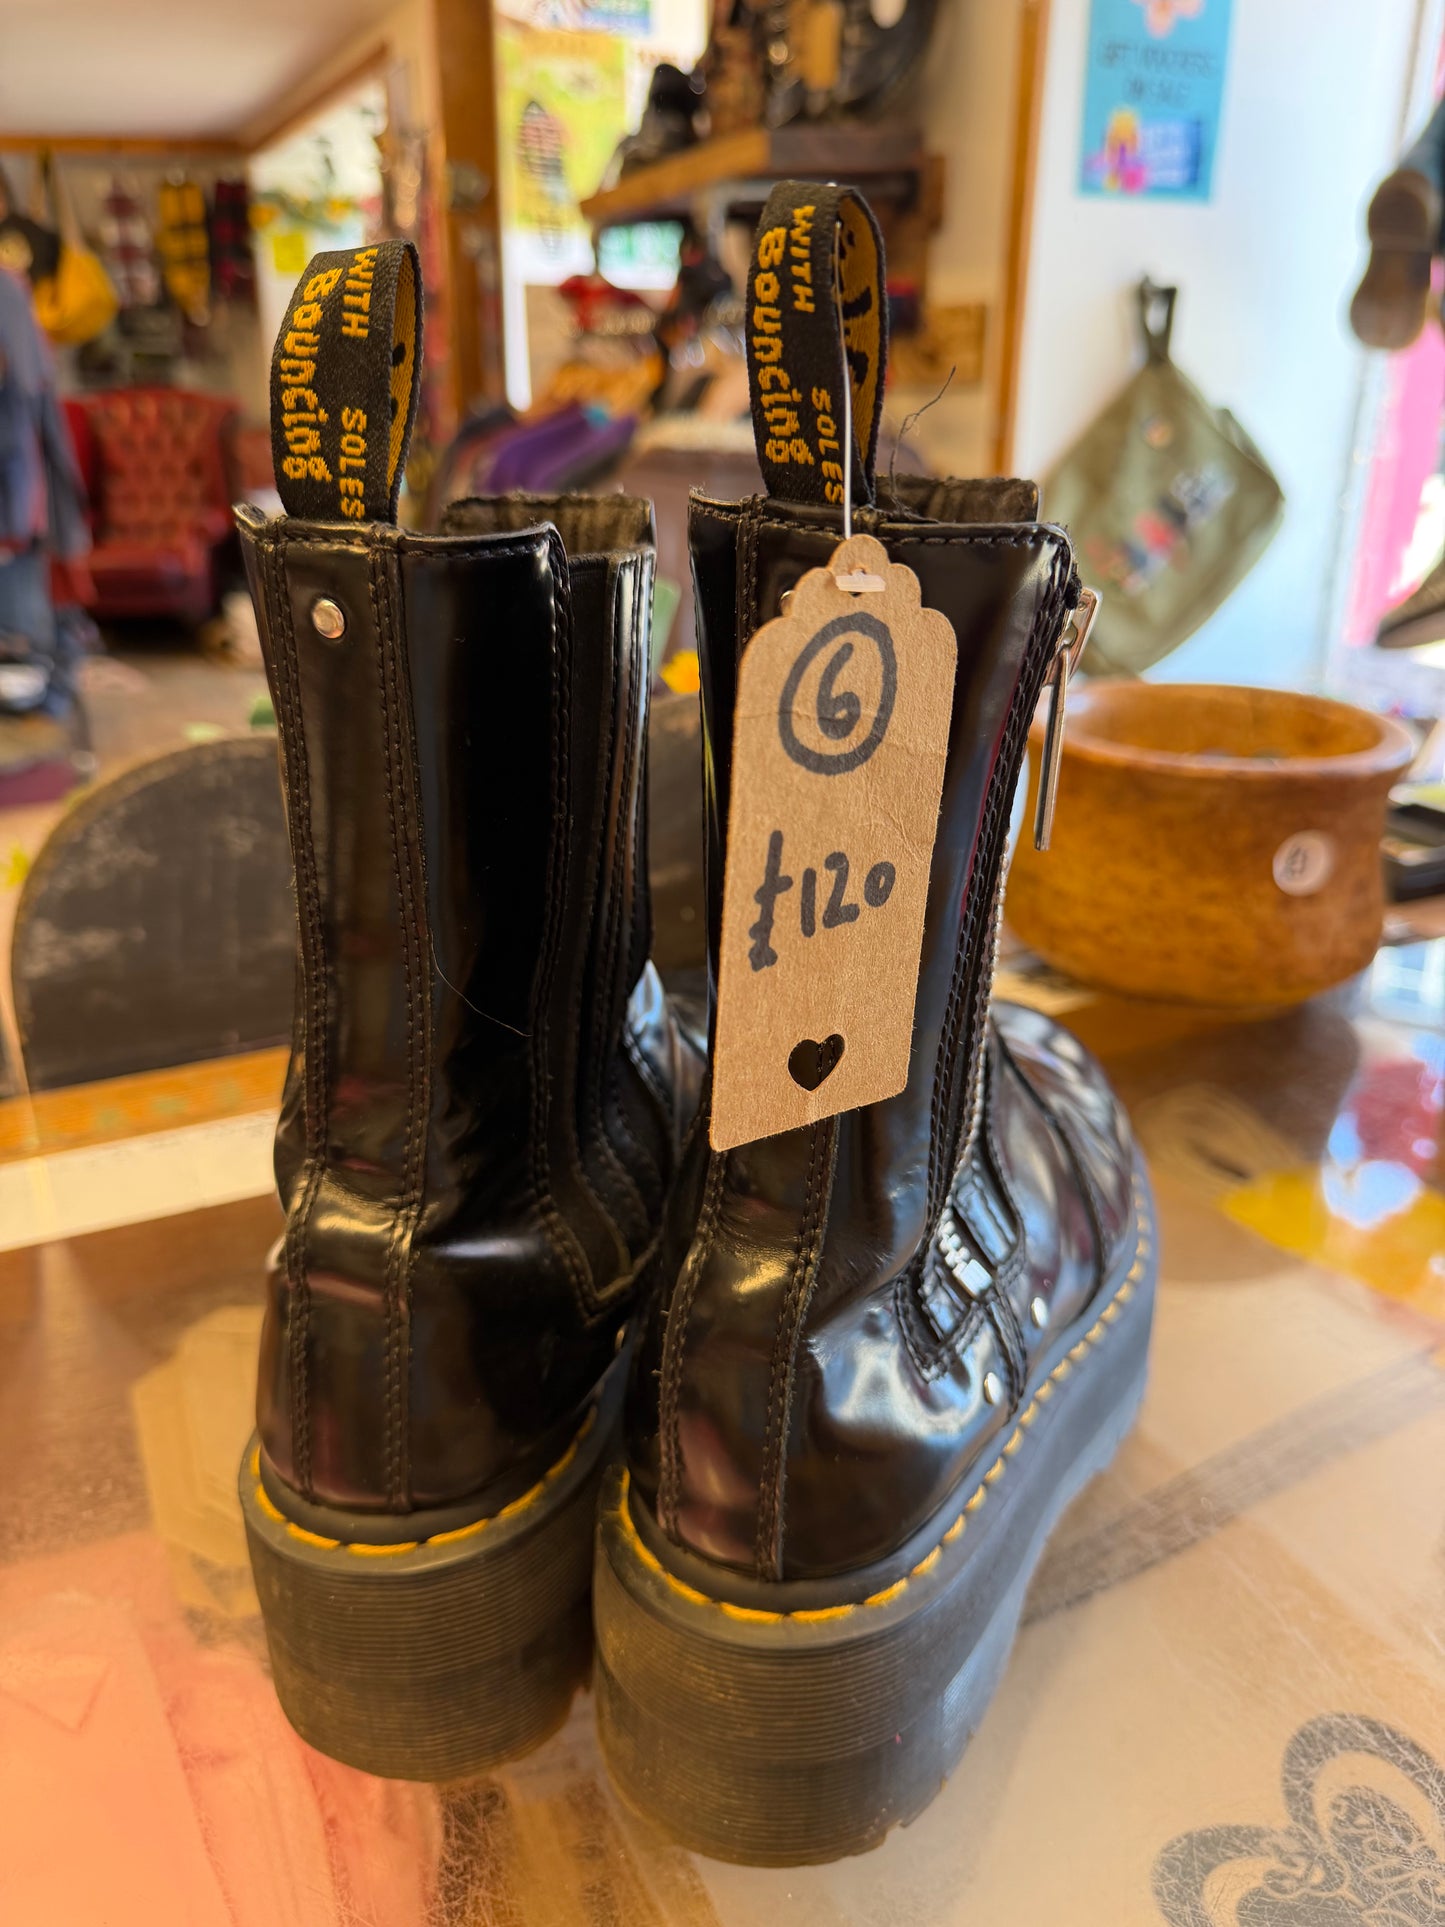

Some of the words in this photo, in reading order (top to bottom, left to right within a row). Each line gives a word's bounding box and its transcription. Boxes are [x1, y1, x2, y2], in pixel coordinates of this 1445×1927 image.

[341, 248, 379, 338] WITH
[789, 205, 816, 314] WITH
[280, 268, 344, 483] Bouncing
[753, 226, 815, 466] Bouncing
[339, 407, 368, 520] SOLES
[811, 386, 845, 505] SOLES
[816, 642, 862, 740] 6
[748, 829, 897, 972] £120
